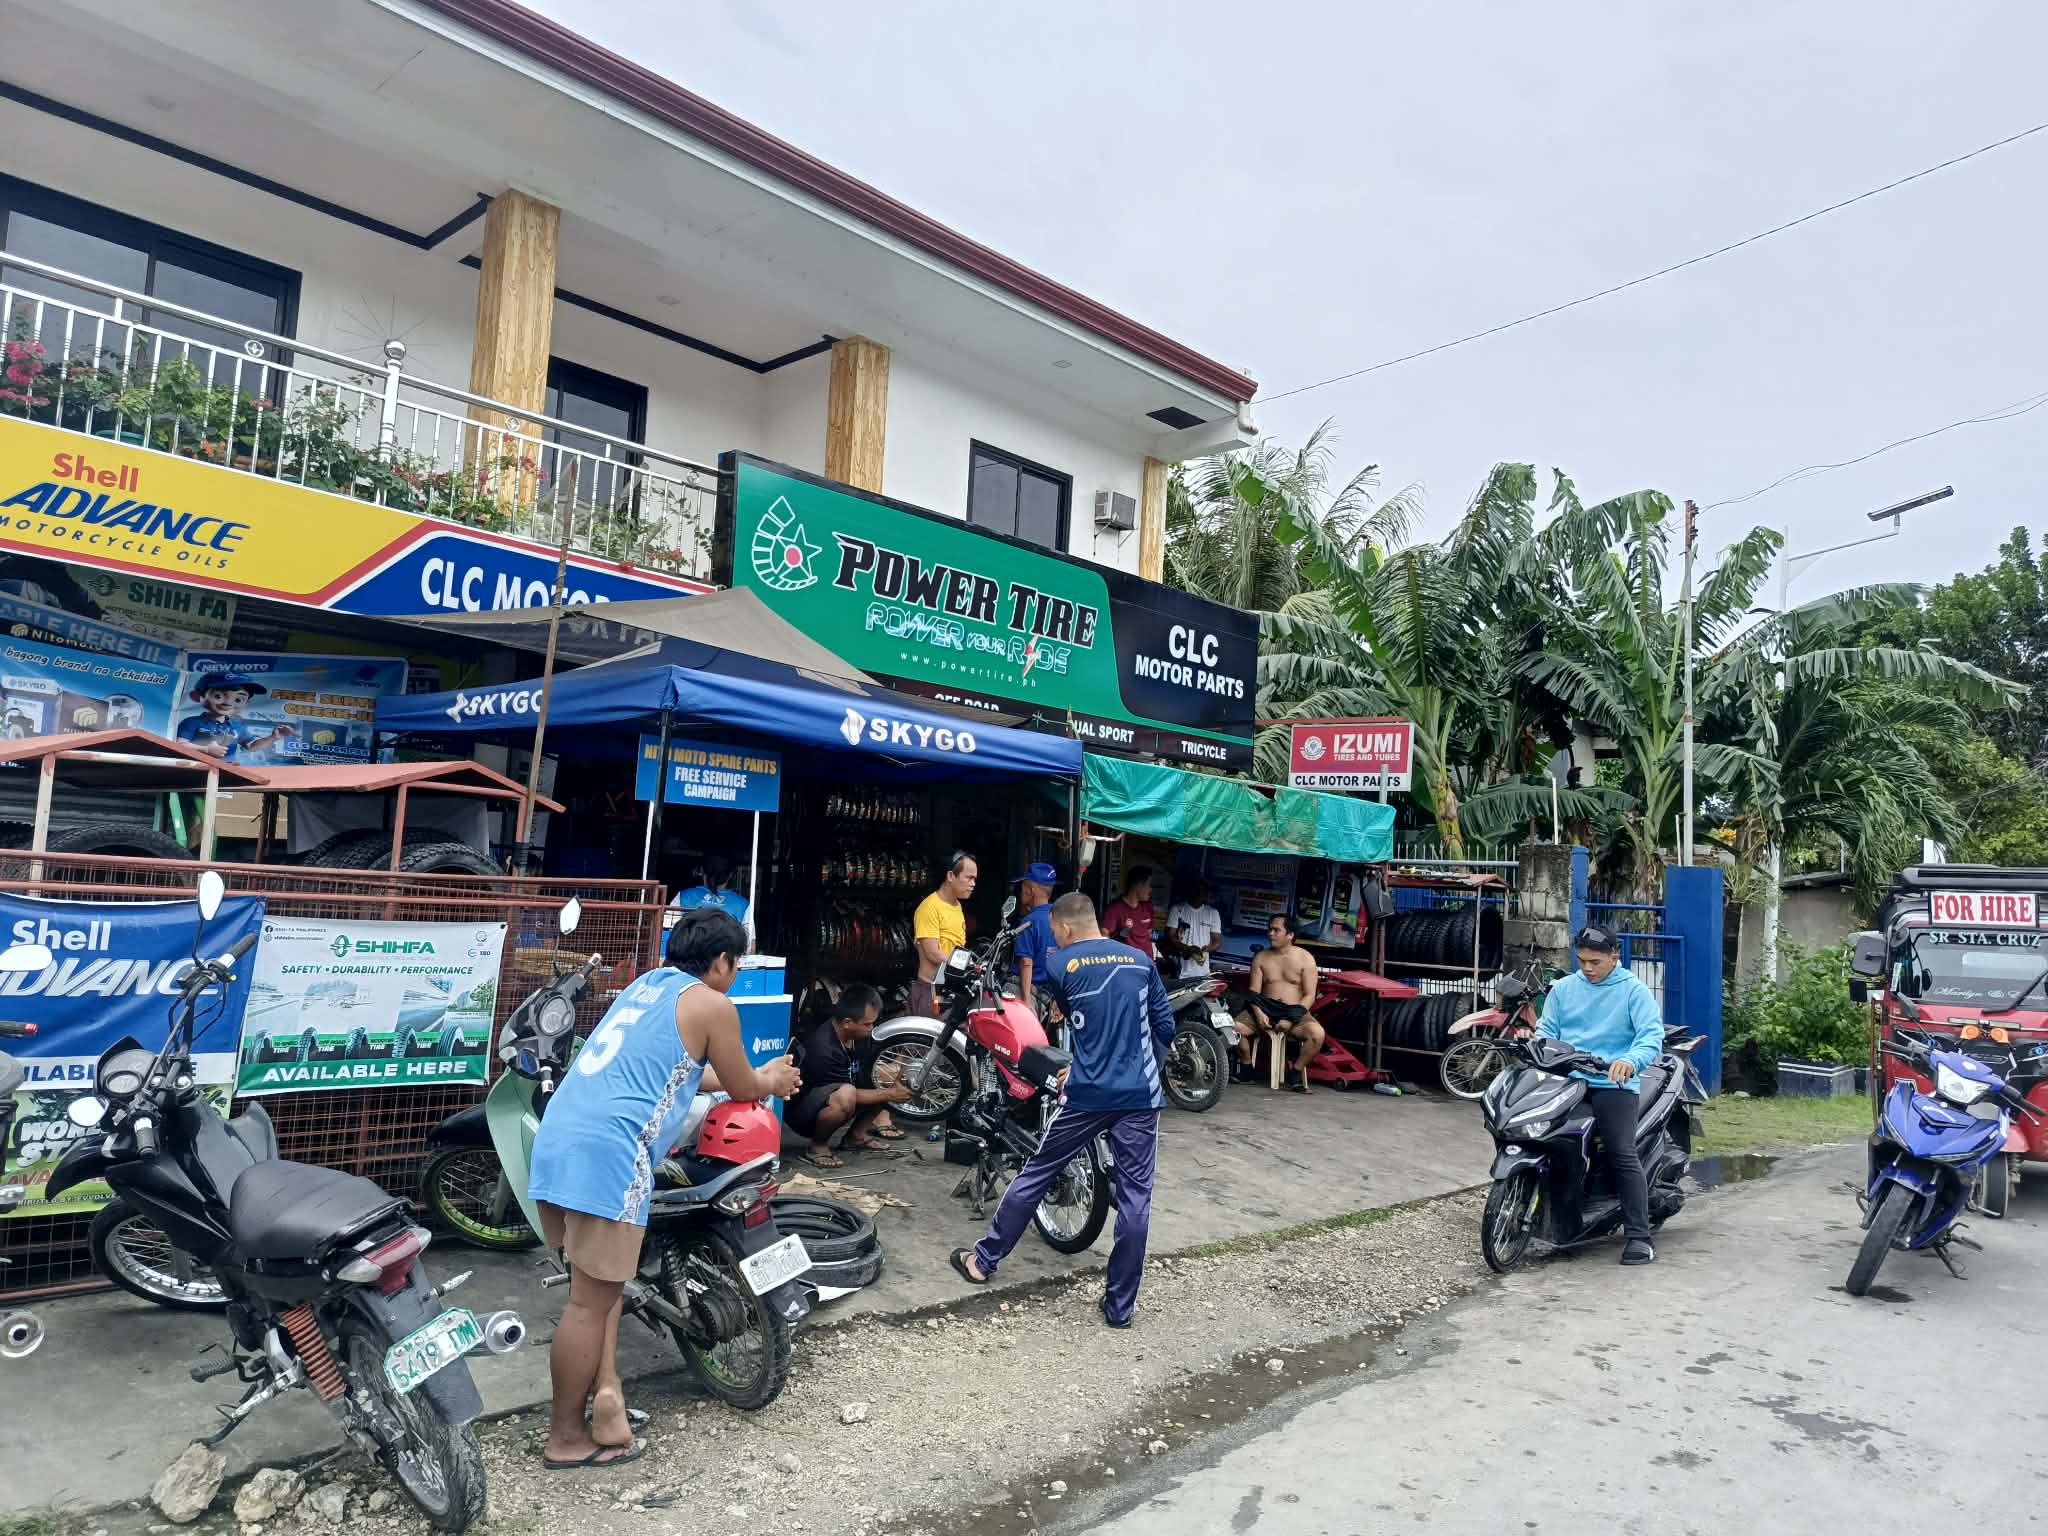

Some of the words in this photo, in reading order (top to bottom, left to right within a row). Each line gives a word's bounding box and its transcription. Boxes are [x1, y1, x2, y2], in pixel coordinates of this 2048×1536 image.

[52, 453, 139, 492] Shell
[1, 482, 250, 552] ADVANCE
[0, 516, 161, 556] MOTORCYCLE
[177, 551, 229, 569] OILS
[128, 582, 191, 612] SHIH
[421, 557, 484, 612] CLC
[832, 532, 999, 625] POWER
[1008, 581, 1098, 649] TIRE
[865, 602, 965, 650] POWER
[966, 632, 1006, 656] YOUR
[1168, 625, 1219, 667] CLC
[6, 647, 49, 665] bagong
[53, 657, 90, 672] brand
[94, 664, 109, 675] na
[113, 668, 168, 684] dekalidad
[1135, 655, 1193, 689] MOTOR
[1197, 671, 1244, 699] PARTS
[868, 717, 976, 752] SKYGO
[1098, 725, 1134, 744] SPORT
[1333, 733, 1402, 754] IZUMI
[674, 748, 706, 766] MOTO
[708, 752, 742, 770] SPARE
[744, 757, 777, 775] PARTS
[1181, 741, 1226, 760] TRICYCLE
[1333, 753, 1355, 761] TIRES
[1357, 753, 1373, 761] AND
[1375, 753, 1401, 761] TUBES
[675, 766, 701, 783] FREE
[702, 770, 747, 788] SERVICE
[1295, 775, 1316, 786] CLC
[1319, 775, 1359, 787] MOTOR
[1362, 776, 1401, 787] PATS
[684, 783, 737, 801] CAMPAIGN
[1933, 895, 1975, 921] FOR
[1980, 896, 2032, 923] HIRE
[10, 919, 111, 951] Shell
[355, 941, 435, 954] SHIHFA
[1929, 931, 1950, 944] SR
[1958, 932, 1992, 945] STA.
[1996, 934, 2041, 947] CRUZ
[0, 957, 218, 997] DVANC
[281, 965, 322, 974] SAFETY
[332, 965, 392, 974] DURABILITY
[401, 966, 473, 975] PERFORMANCE
[760, 1038, 785, 1052] SKYGO
[263, 1062, 399, 1082] AVAILABLE
[406, 1061, 468, 1076] HERE
